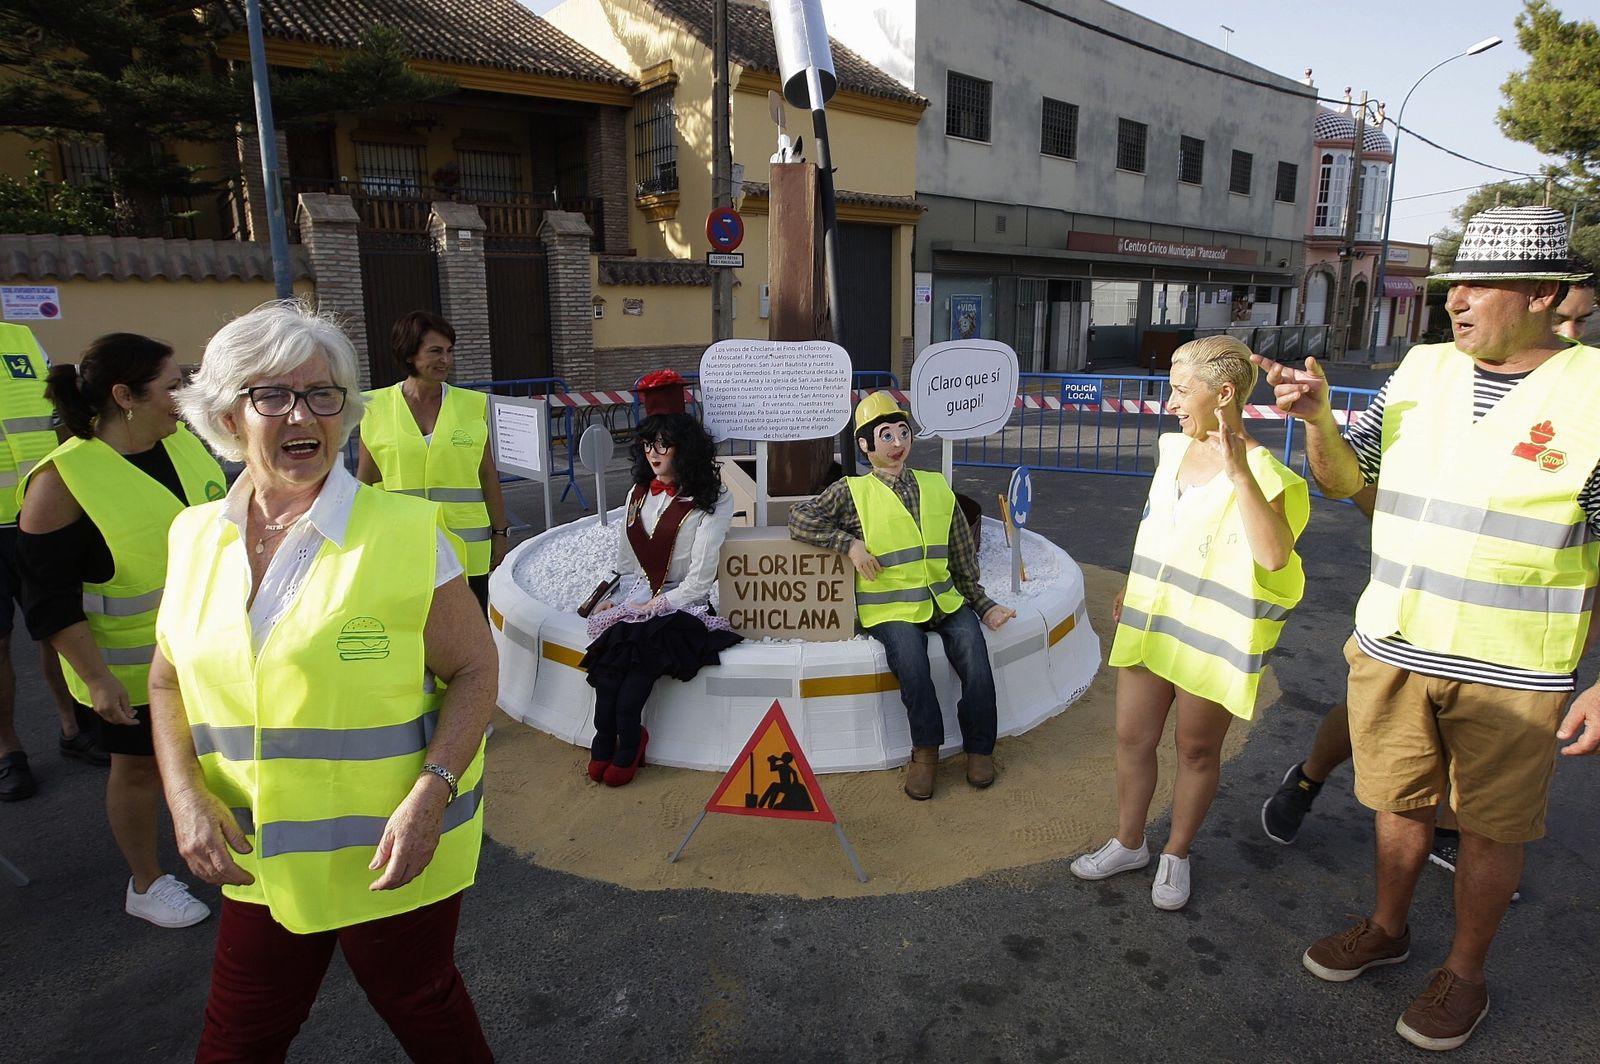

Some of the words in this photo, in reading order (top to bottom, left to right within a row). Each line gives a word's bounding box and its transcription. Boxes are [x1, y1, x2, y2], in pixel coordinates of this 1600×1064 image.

[1124, 240, 1146, 252] Centro
[1168, 244, 1196, 258] Municipal
[928, 374, 962, 396] ¡Claro
[965, 374, 987, 388] que
[992, 368, 1001, 382] sí
[946, 394, 984, 416] guapi!
[1543, 456, 1563, 465] STOP
[726, 554, 845, 577] GLORIETA
[734, 581, 807, 602] VINOS
[817, 580, 844, 602] DE
[729, 609, 840, 630] CHICLANA
